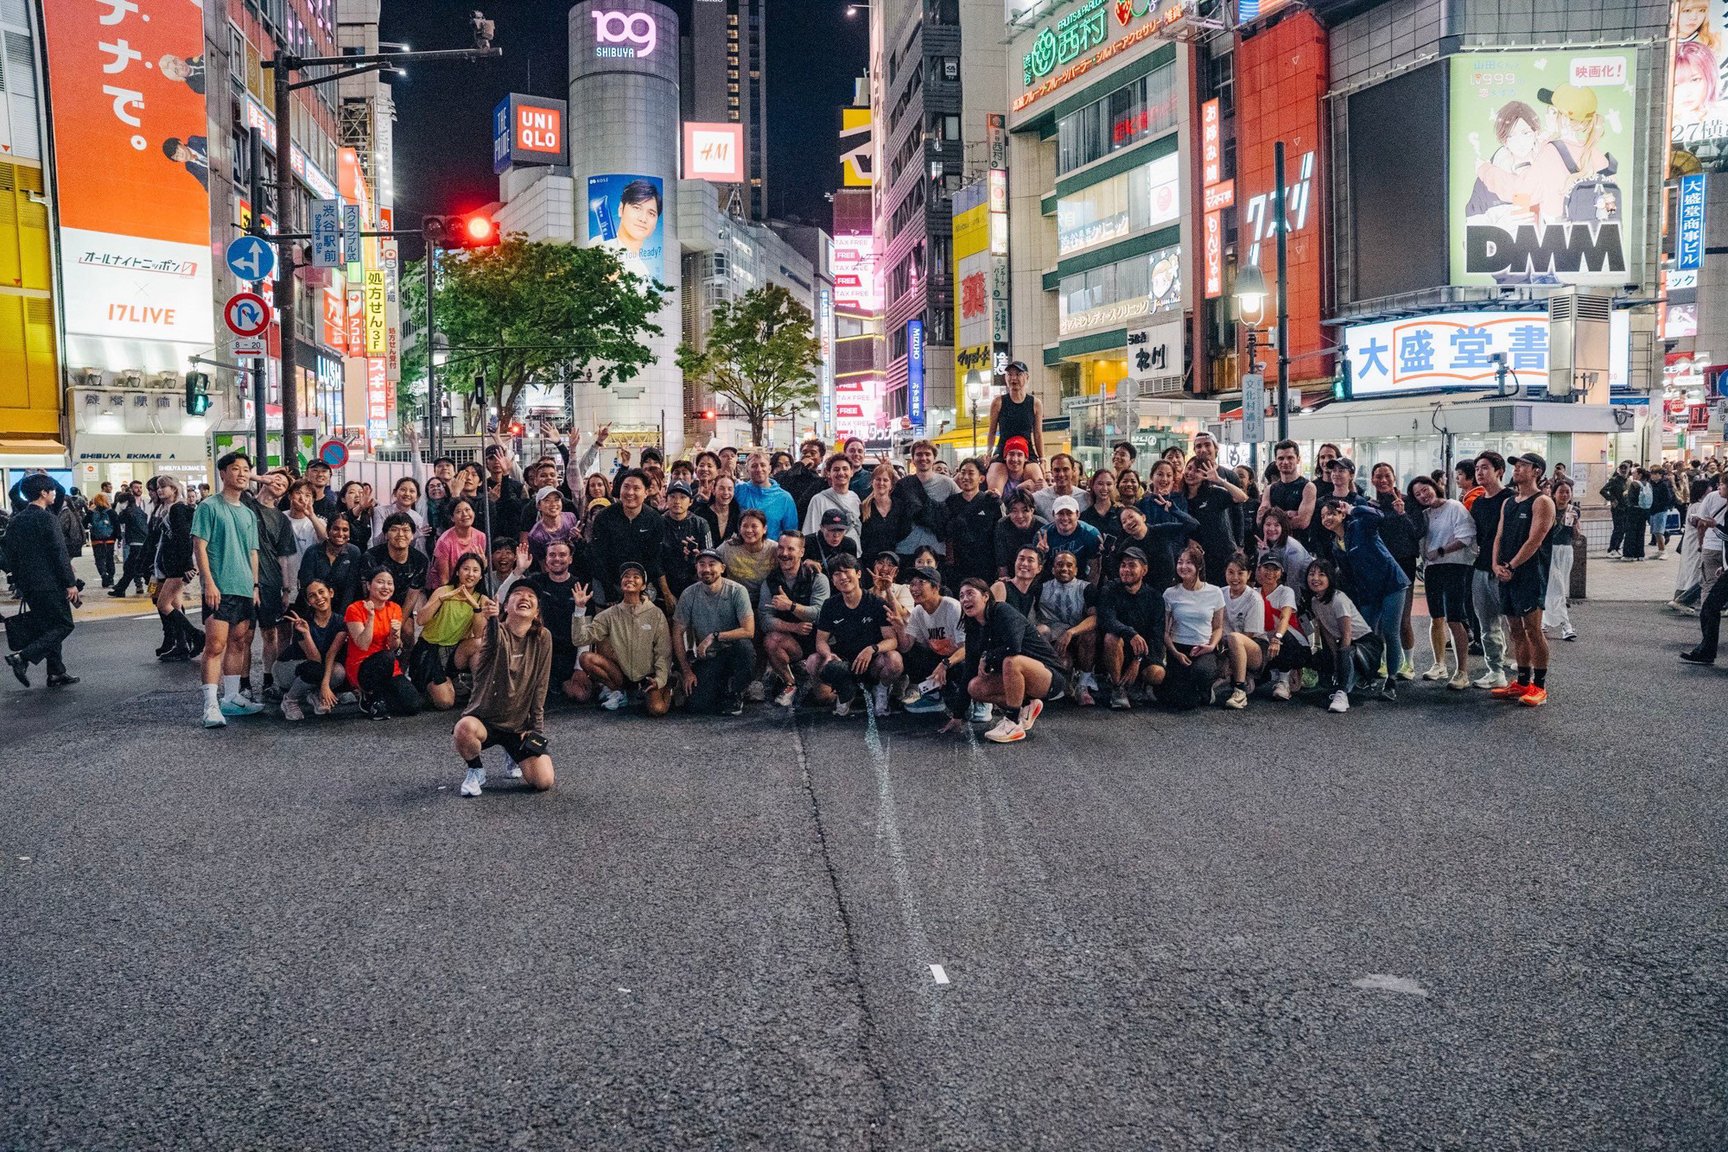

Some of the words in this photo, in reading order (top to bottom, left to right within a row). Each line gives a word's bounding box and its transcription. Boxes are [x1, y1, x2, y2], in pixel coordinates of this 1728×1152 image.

[592, 11, 656, 57] 109
[1058, 8, 1106, 65] 西村
[596, 47, 634, 58] SHIBUYA
[1575, 64, 1622, 78] 映画化!
[522, 111, 553, 130] UNI
[522, 129, 555, 148] QLO
[700, 142, 729, 161] H&M
[323, 205, 336, 262] 渋谷駅前
[347, 207, 357, 260] スクランブル式
[1682, 180, 1701, 265] 大盛堂商事ビル
[84, 251, 181, 273] オールナイトニッポン
[639, 247, 662, 258] Ready?
[837, 251, 856, 259] FREE
[1466, 224, 1626, 273] DMM
[108, 303, 176, 325] 17LIVE
[369, 272, 382, 349] 処方せん3F
[351, 318, 360, 344] アコム
[912, 327, 920, 360] MIZUHO
[317, 355, 342, 391] LUSH
[1246, 379, 1256, 432] 文化村通り
